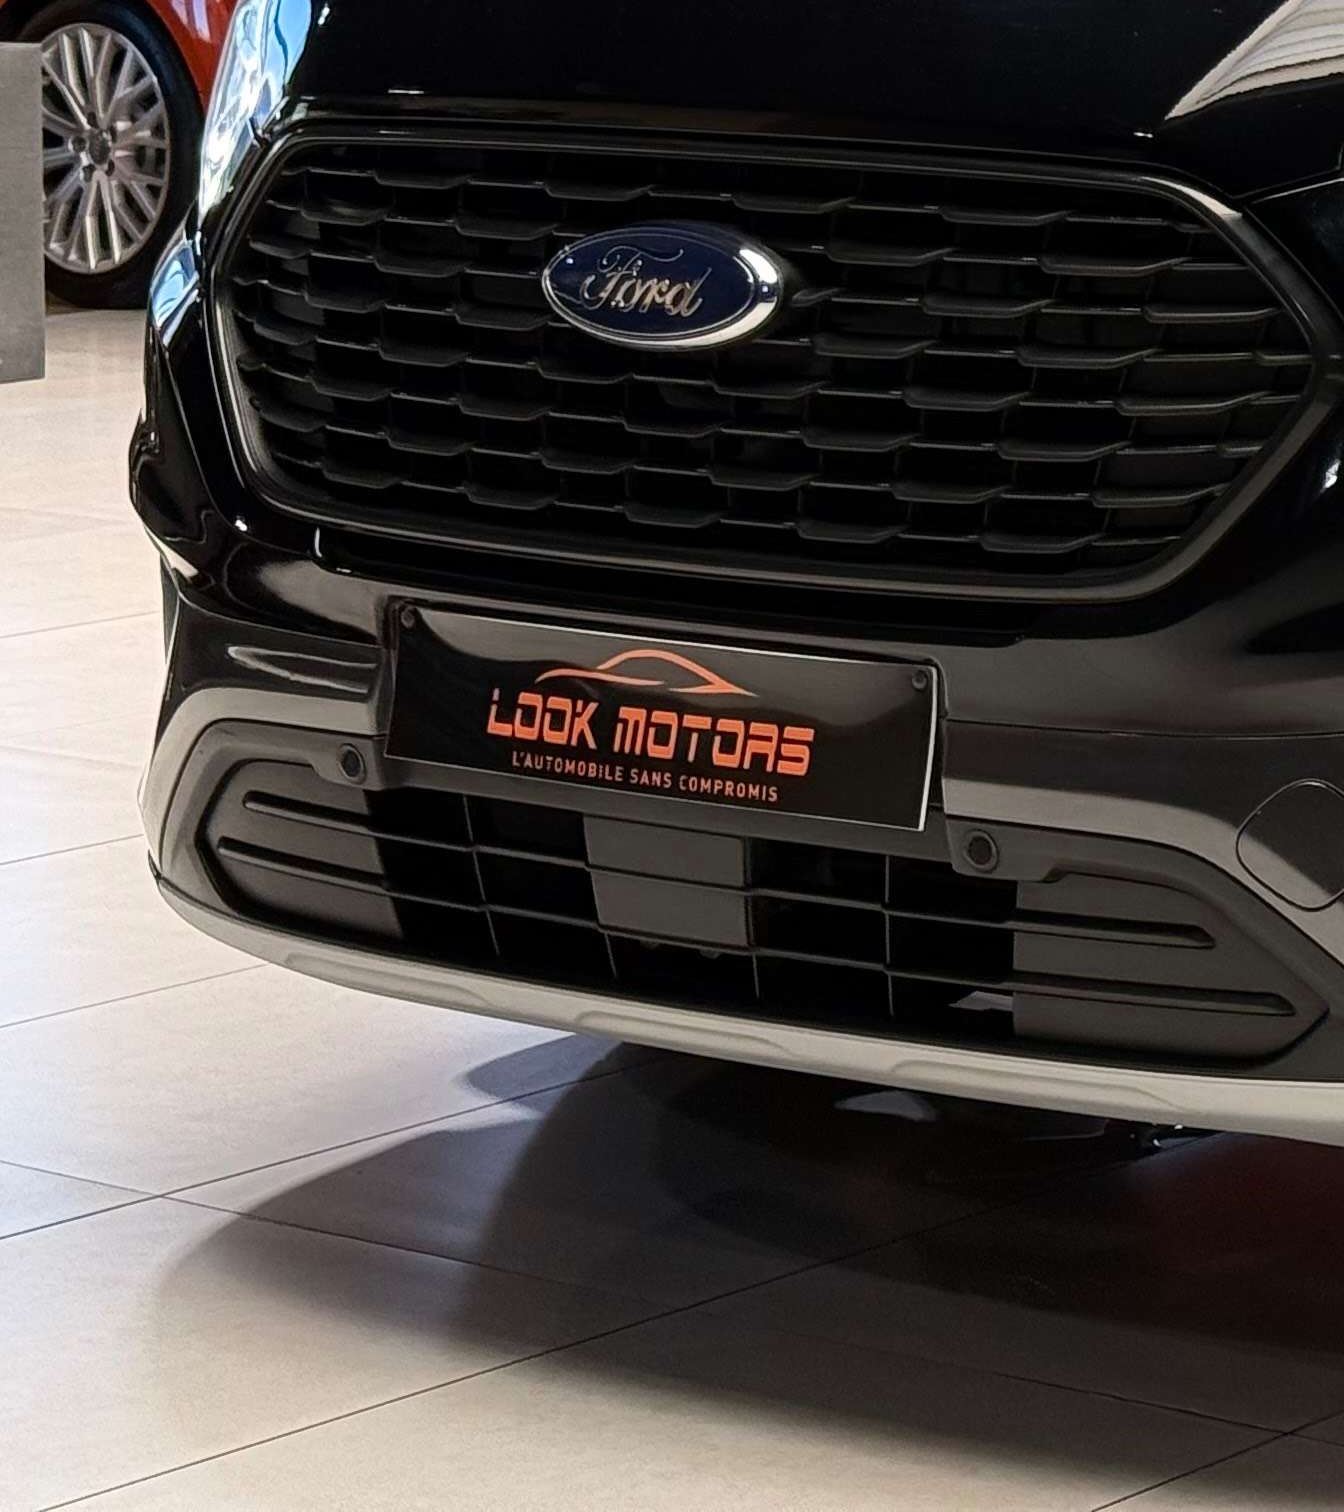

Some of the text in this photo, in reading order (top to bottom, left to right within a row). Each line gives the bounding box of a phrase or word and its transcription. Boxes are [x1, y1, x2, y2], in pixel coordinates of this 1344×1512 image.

[578, 245, 713, 318] Ford
[487, 687, 815, 777] LOOK MOTORS
[511, 750, 779, 803] L'AUTOMOBILE SANS COMPROMIS
